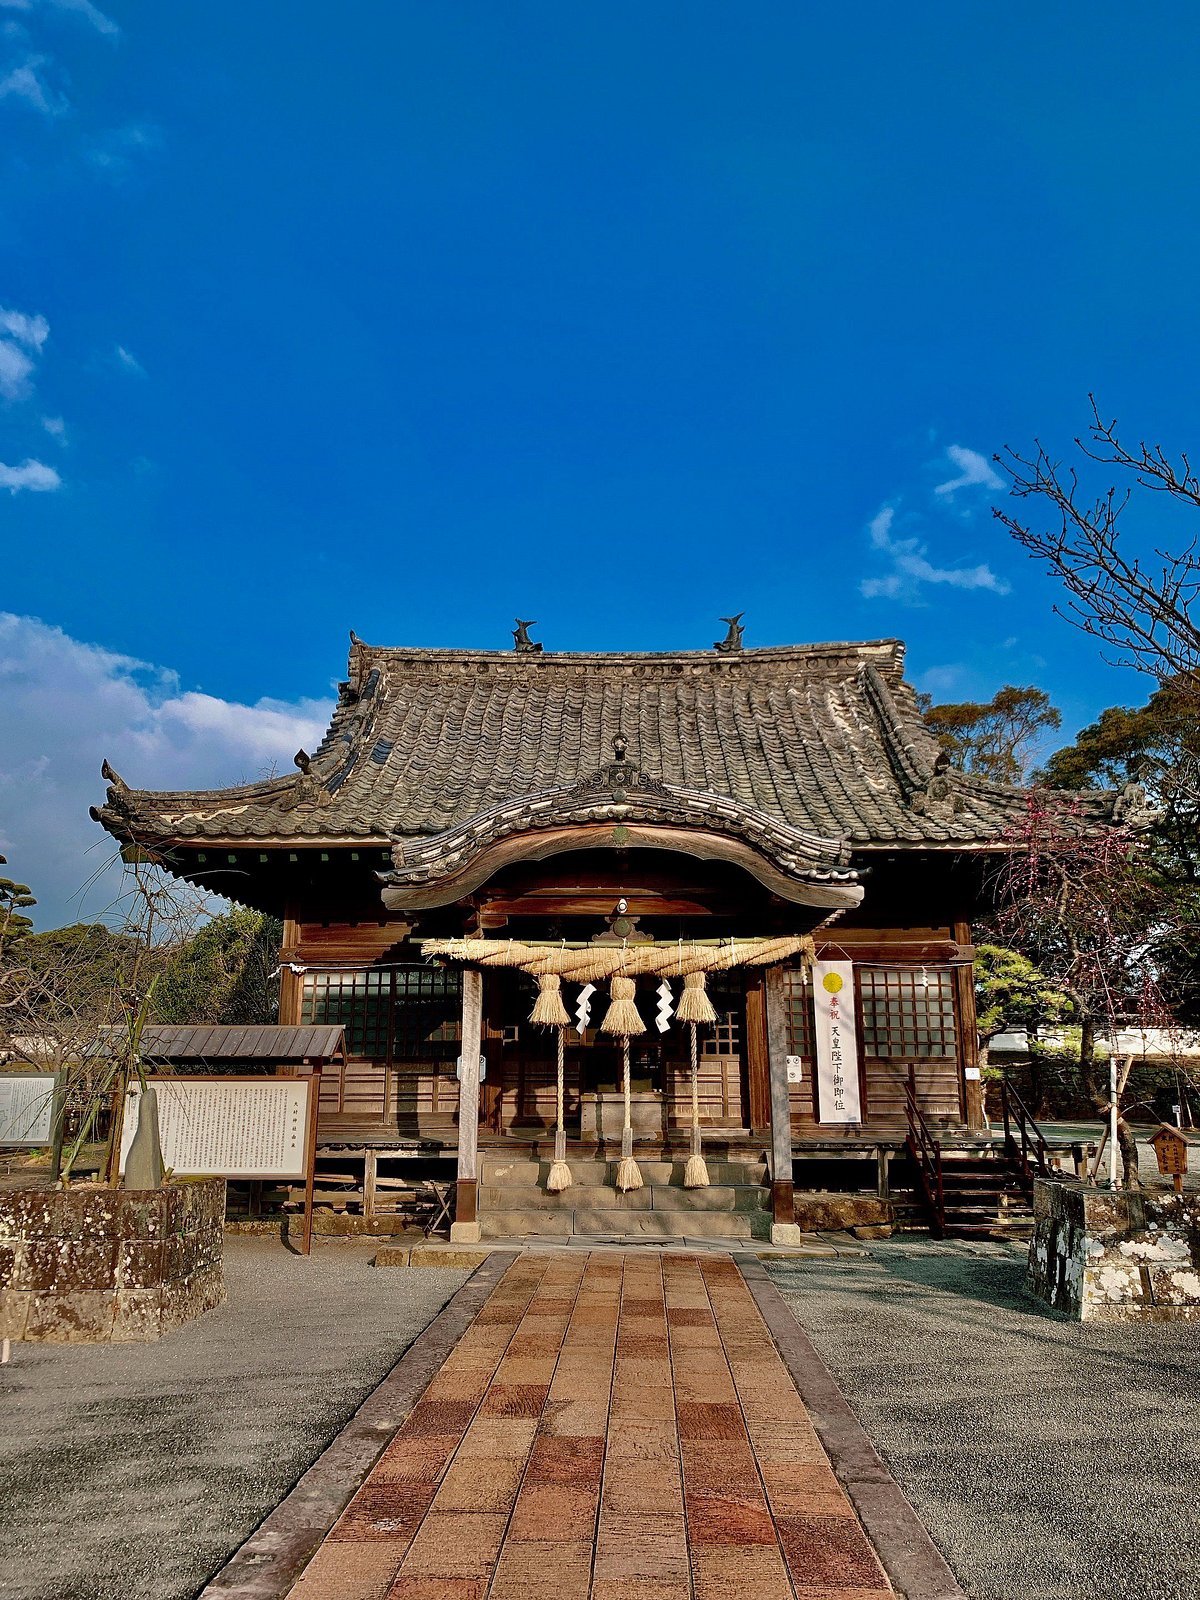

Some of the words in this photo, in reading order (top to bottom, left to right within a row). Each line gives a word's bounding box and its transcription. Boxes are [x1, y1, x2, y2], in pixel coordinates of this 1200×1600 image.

[829, 996, 840, 1020] 奉祝
[831, 1026, 845, 1111] 天皇陛下御即位
